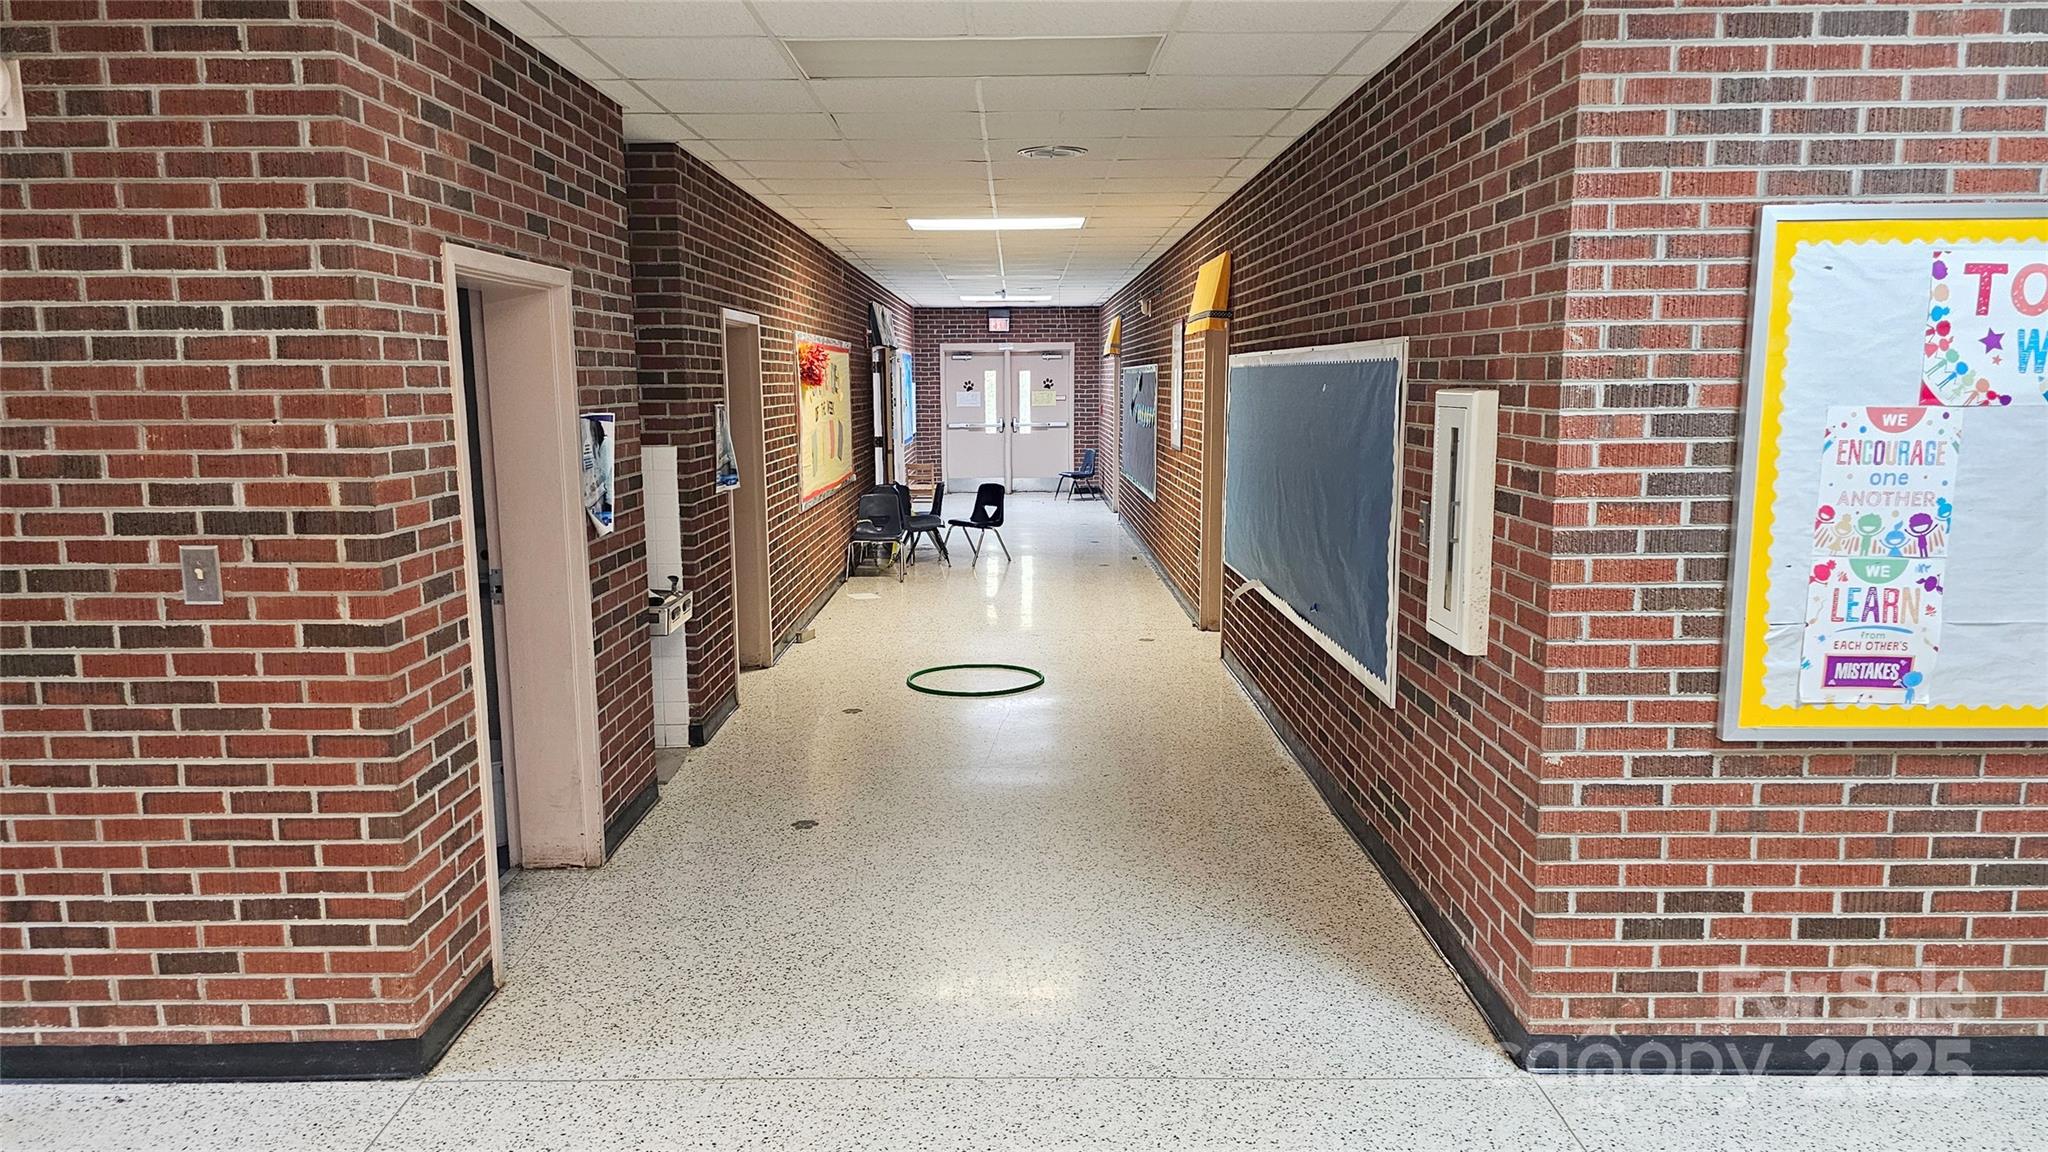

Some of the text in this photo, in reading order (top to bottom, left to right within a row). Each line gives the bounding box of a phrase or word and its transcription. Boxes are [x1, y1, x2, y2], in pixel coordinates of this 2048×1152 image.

[1882, 413, 1909, 427] WE
[1836, 439, 1948, 466] ENCOURAGE
[1869, 472, 1909, 486] one
[1836, 490, 1936, 507] ANOTHER
[1865, 564, 1891, 578] WE
[1831, 586, 1921, 625] LEARN
[1860, 631, 1886, 640] from
[1833, 640, 1909, 652] EACH OTHER'S
[1833, 661, 1900, 681] MISTAKES
